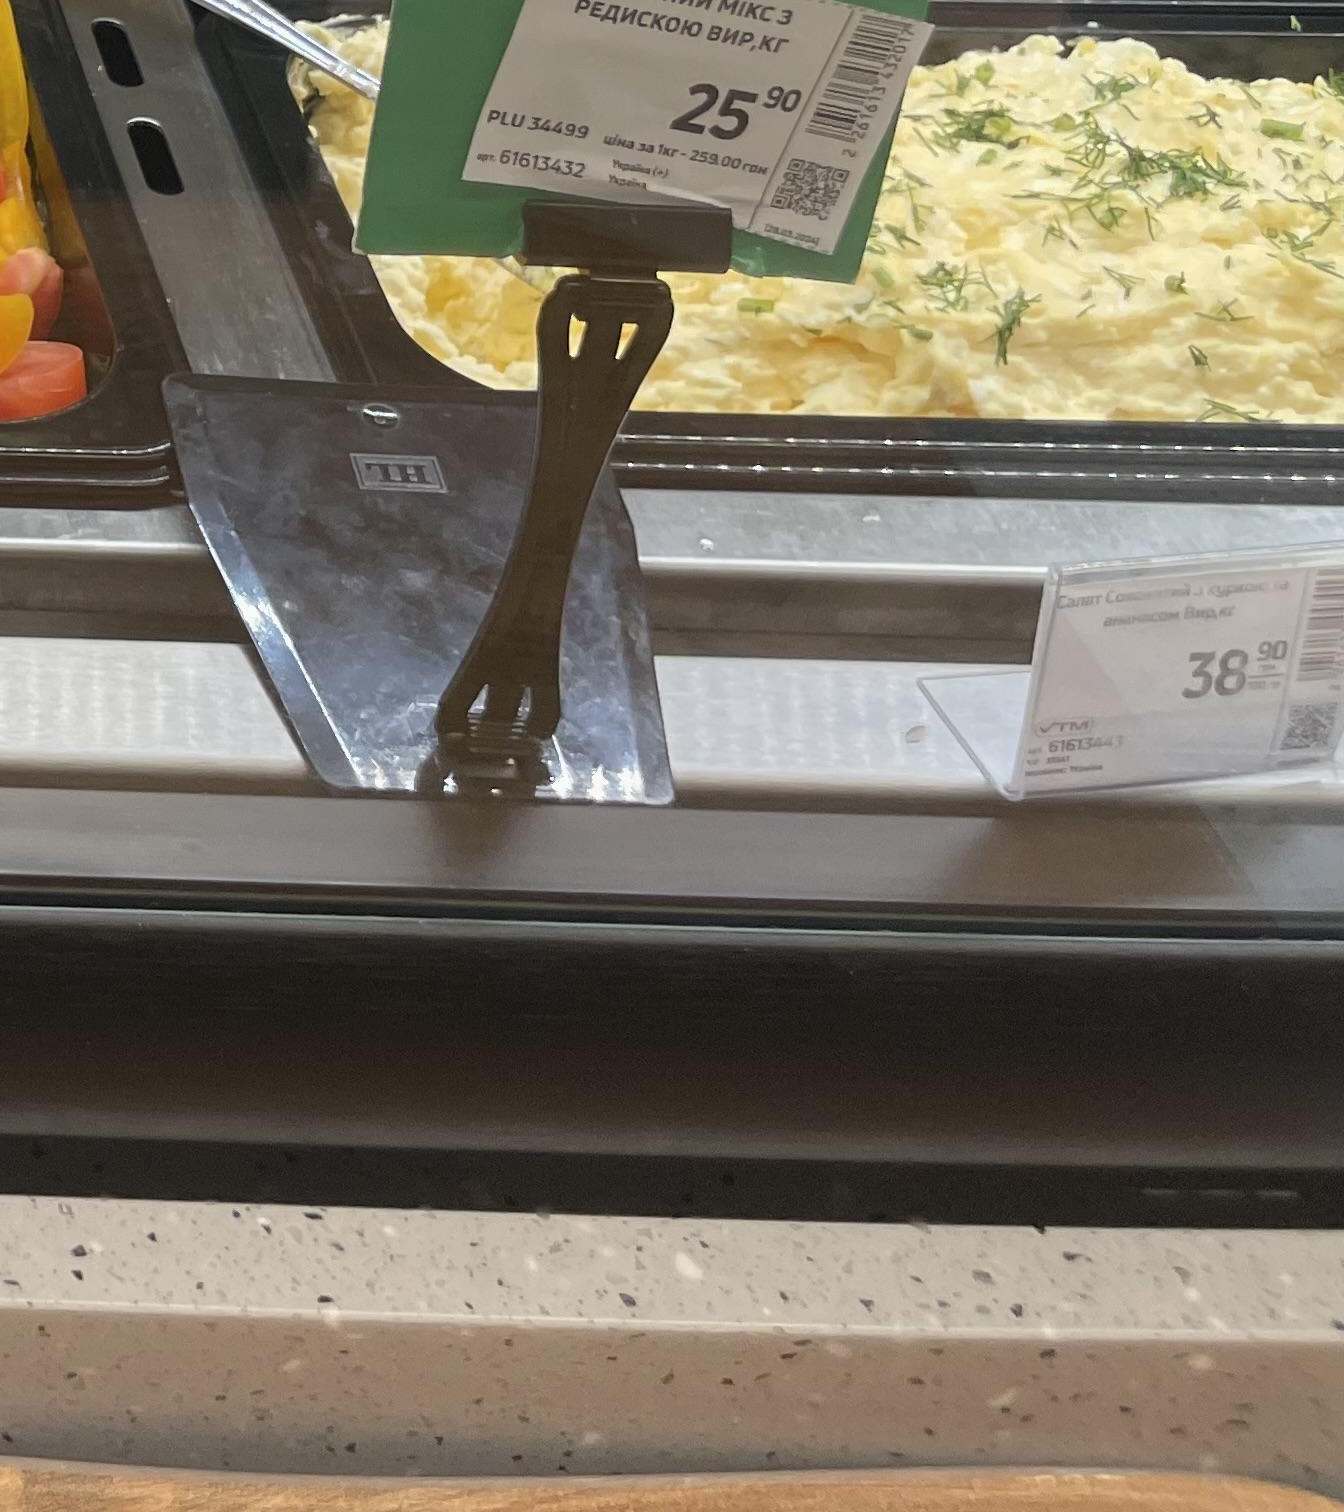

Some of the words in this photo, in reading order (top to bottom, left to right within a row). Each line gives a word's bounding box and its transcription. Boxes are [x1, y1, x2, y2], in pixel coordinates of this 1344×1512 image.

[486, 109, 526, 128] PLU
[526, 116, 590, 140] 34499
[669, 82, 760, 141] 25
[762, 85, 803, 113] 90
[850, 85, 887, 140] 261613
[499, 148, 586, 179] 61613432
[602, 134, 635, 151] ціна
[636, 141, 655, 154] за
[1181, 648, 1249, 700] 38
[1256, 639, 1289, 662] 90
